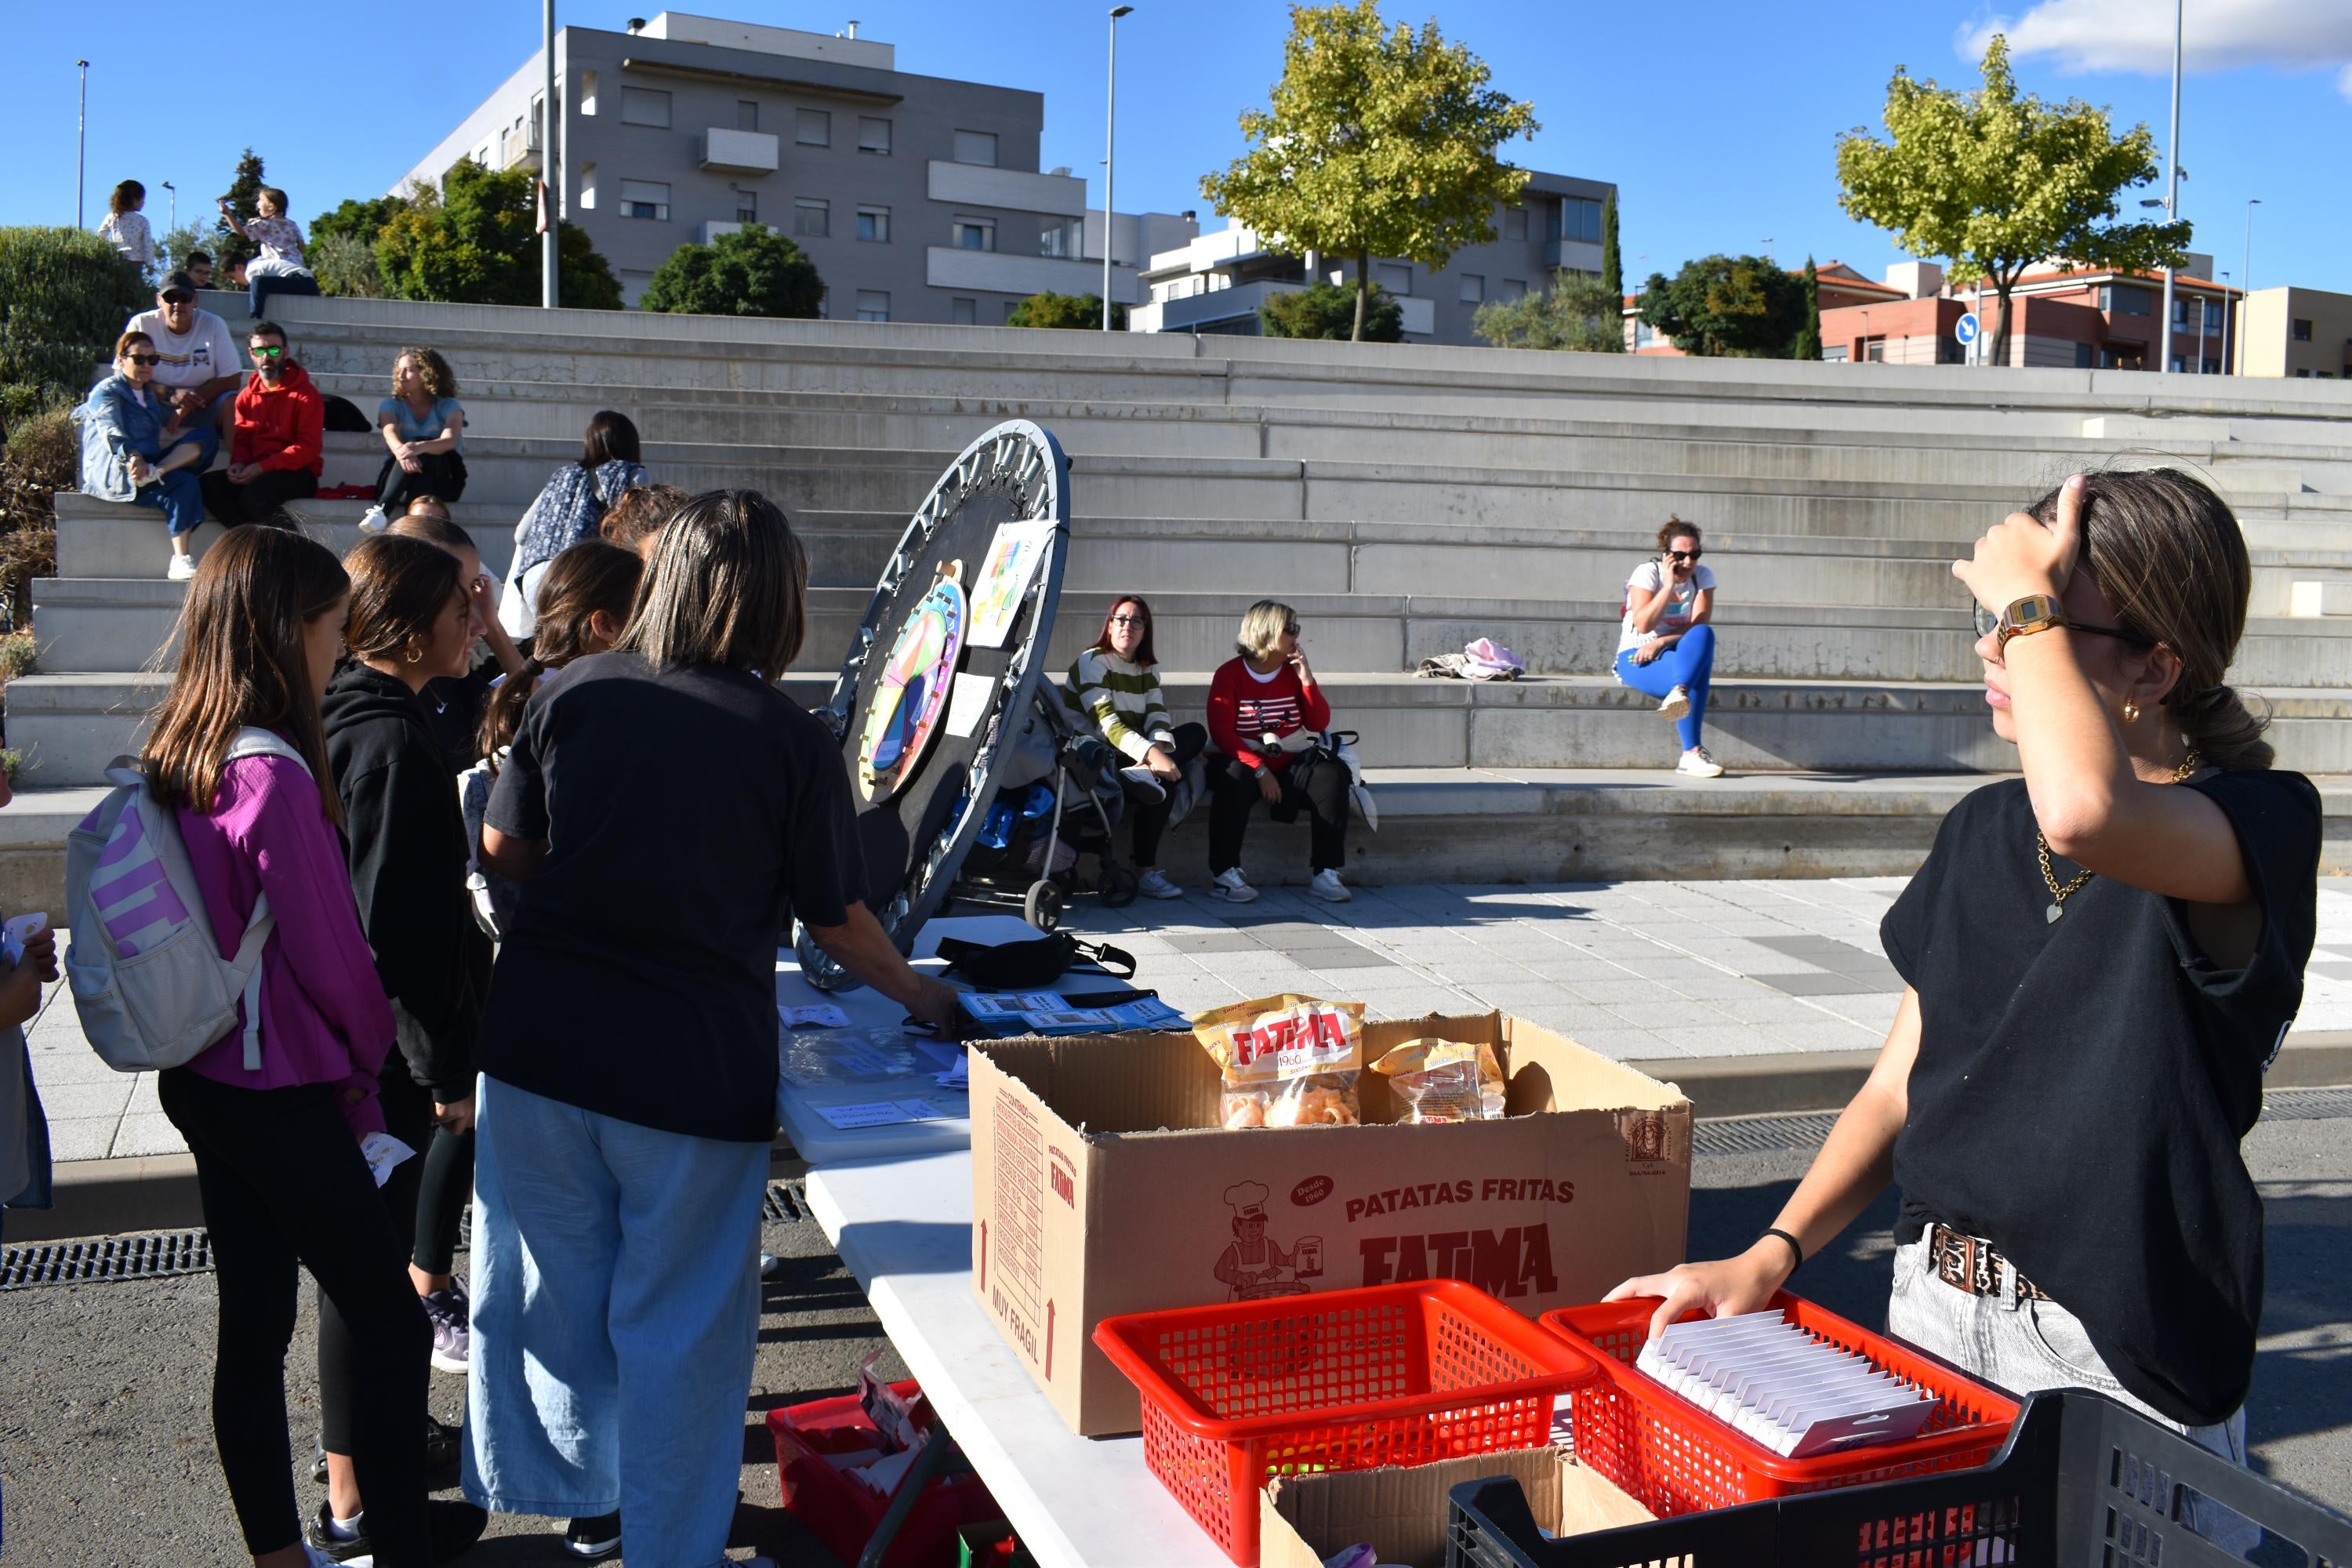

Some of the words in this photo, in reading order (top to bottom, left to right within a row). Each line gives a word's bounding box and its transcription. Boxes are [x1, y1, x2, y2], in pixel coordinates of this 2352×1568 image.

[1232, 1012, 1347, 1067] FATIMA
[1279, 1054, 1301, 1067] 1960
[1051, 1160, 1074, 1210] FATIMA
[1297, 1178, 1325, 1196] Desde
[1305, 1189, 1324, 1203] 1960
[1345, 1179, 1474, 1223] PATATAS
[1481, 1178, 1575, 1204] FRITAS
[1359, 1223, 1558, 1298] FATIMA
[993, 1284, 1009, 1323] MUY
[1010, 1308, 1038, 1365] FRAGIL
